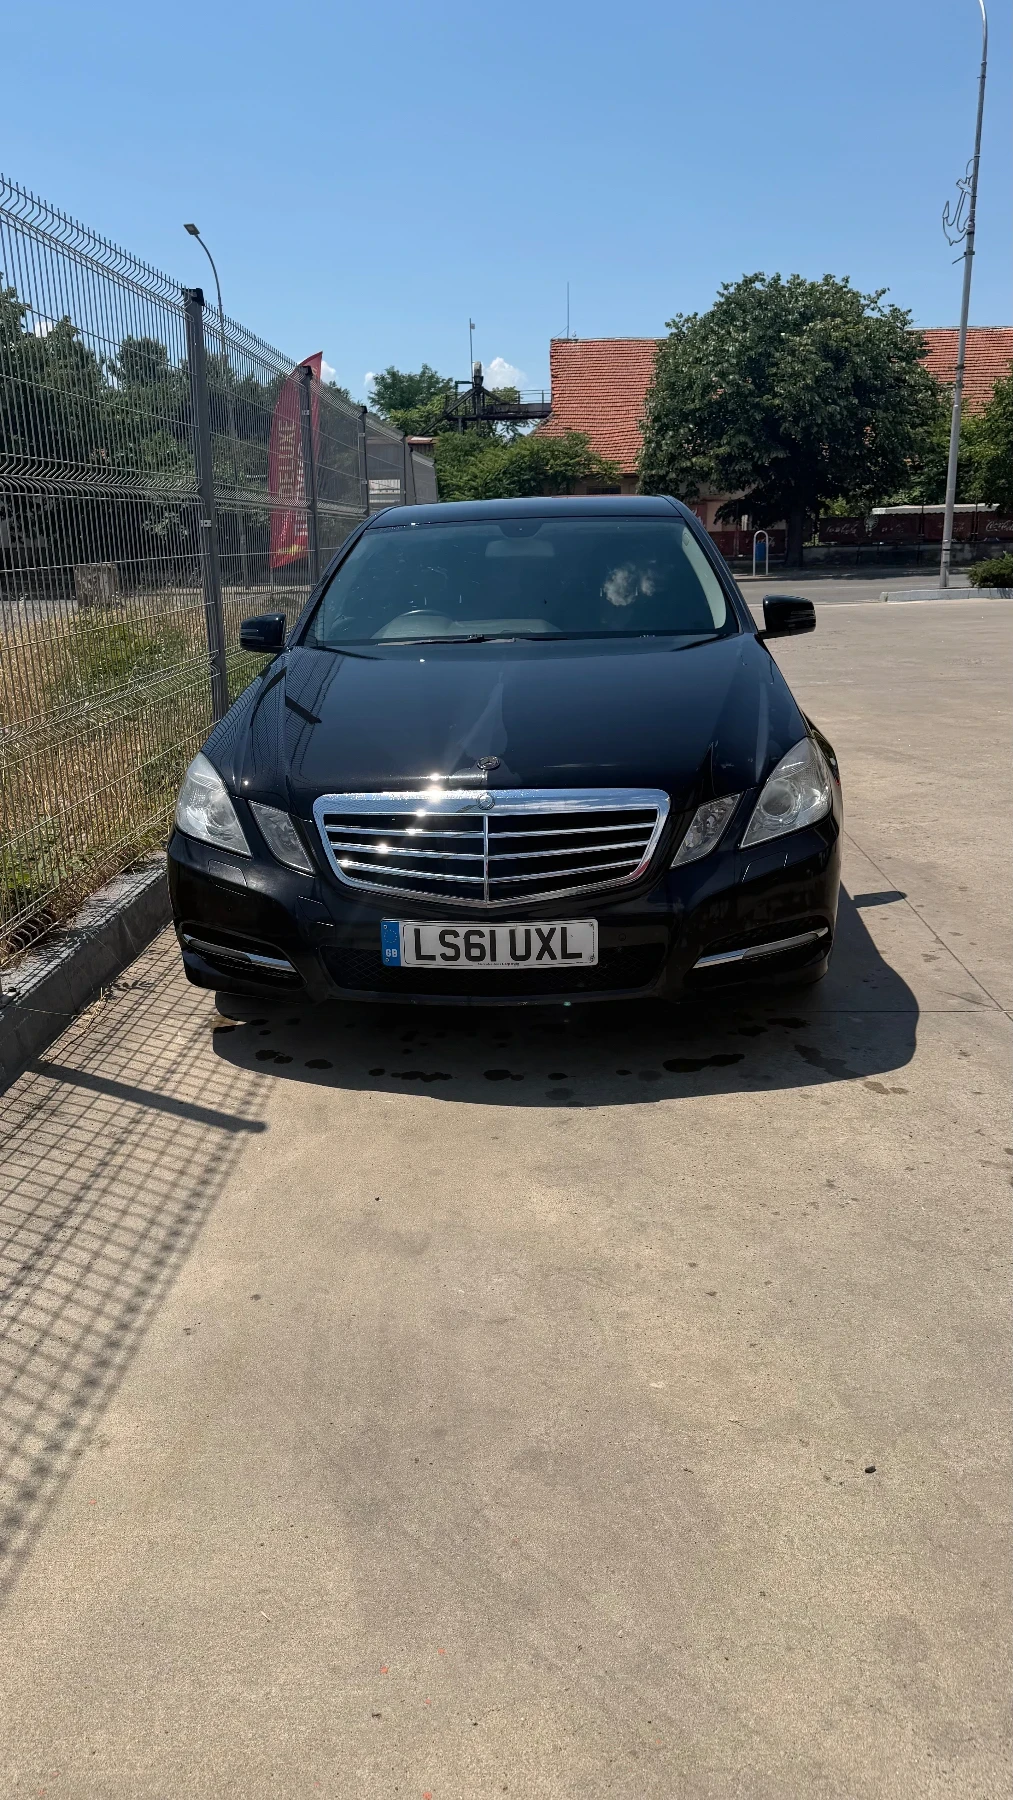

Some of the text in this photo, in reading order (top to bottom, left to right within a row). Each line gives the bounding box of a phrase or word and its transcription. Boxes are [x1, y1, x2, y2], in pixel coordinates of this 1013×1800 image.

[278, 420, 295, 499] DELUXE
[385, 948, 398, 958] GB
[413, 926, 583, 962] LS61 UXL
